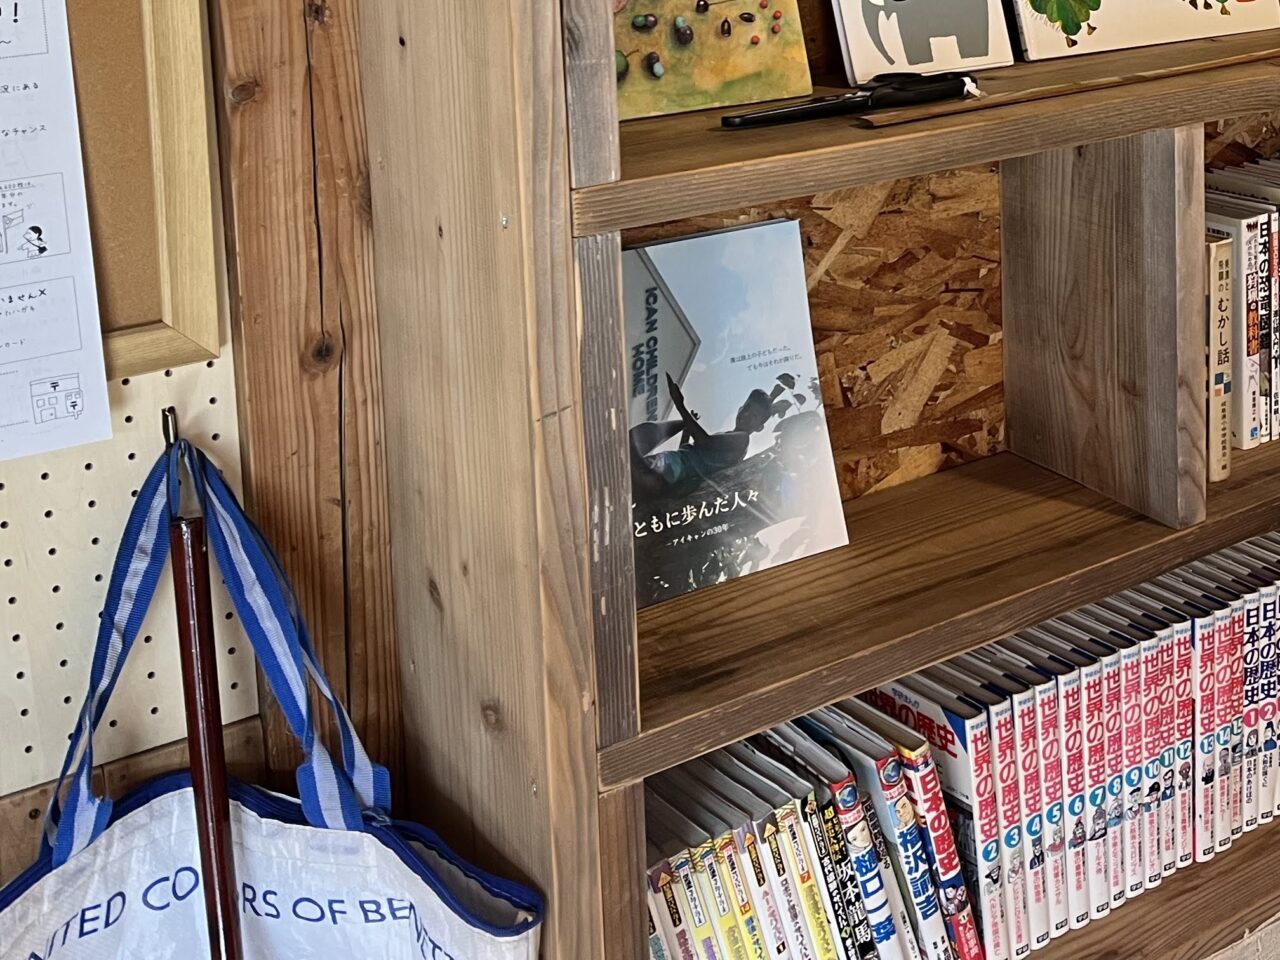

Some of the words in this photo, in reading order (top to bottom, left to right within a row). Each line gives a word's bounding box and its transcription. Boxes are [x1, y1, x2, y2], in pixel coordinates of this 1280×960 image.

[645, 287, 658, 334] ICAN
[1217, 298, 1230, 366] むかし話
[632, 343, 646, 398] HOME
[634, 490, 759, 538] ともに歩んだ人々
[1159, 642, 1175, 747] 世界の歴史
[1175, 636, 1192, 742] 世界の歴史
[1200, 634, 1215, 737] 世界の歴史
[1215, 623, 1232, 727] 世界の歴史
[1244, 608, 1260, 707] 日本の歴史
[1259, 602, 1277, 701] 日本の歴史
[1039, 692, 1063, 806] 世界の歴史
[1063, 685, 1085, 797] 世界の歴史
[1085, 680, 1107, 788] 世界の歴史
[1104, 669, 1123, 777] 世界の歴史
[1123, 658, 1143, 768] 世界の歴史
[1142, 651, 1161, 759] 世界の歴史
[971, 728, 999, 844] 世界の歴史
[995, 716, 1020, 830] 世界の歴史
[1018, 706, 1041, 817] 世界の歴史
[897, 820, 941, 920] 福沢諭吉
[919, 768, 961, 877] 日本の歴史
[292, 897, 347, 925] OF
[836, 857, 872, 944] 坂本龍馬
[853, 851, 897, 944] 樋口一葉
